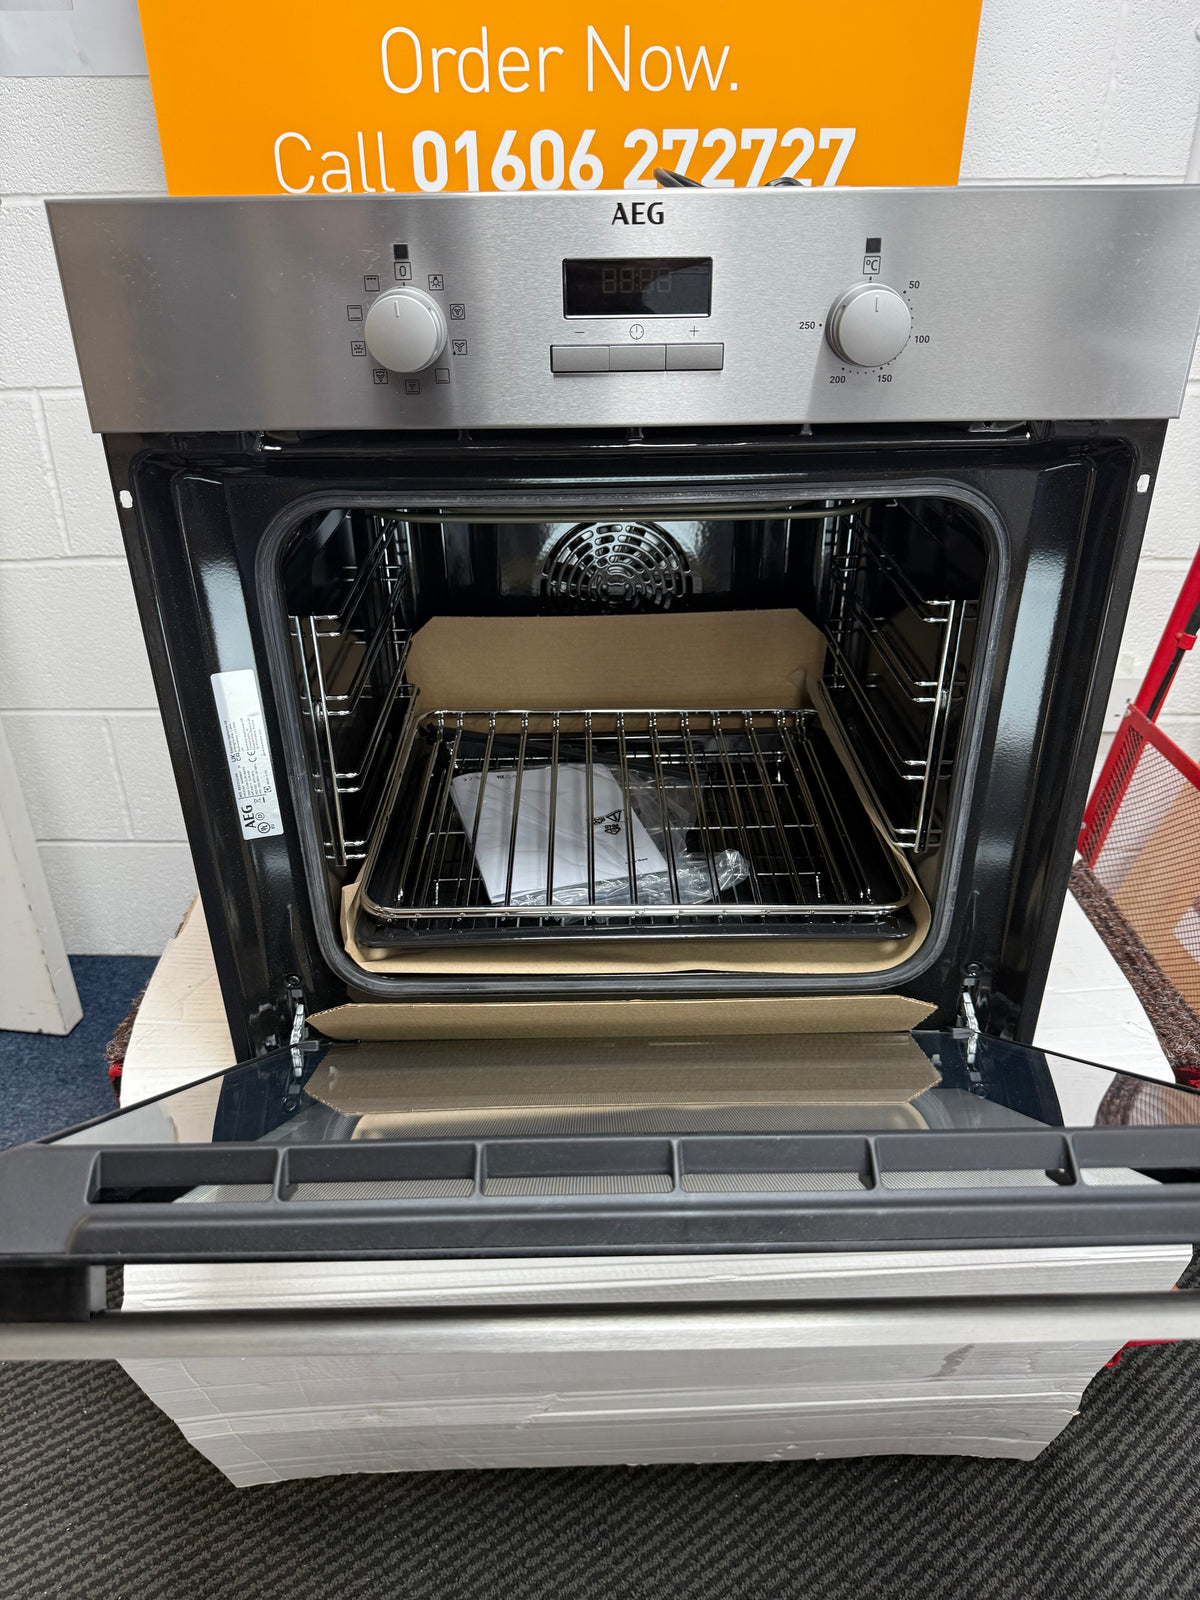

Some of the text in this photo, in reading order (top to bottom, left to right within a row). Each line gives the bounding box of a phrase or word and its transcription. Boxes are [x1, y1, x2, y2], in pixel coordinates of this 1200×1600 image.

[381, 25, 738, 94] Order Now.
[274, 127, 857, 194] Call 01606 272727
[611, 202, 665, 225] AEG
[908, 280, 920, 289] 50
[799, 321, 815, 330] 250
[914, 335, 930, 344] 100
[829, 375, 846, 384] 200
[876, 374, 892, 383] 150
[241, 804, 257, 829] AEG
